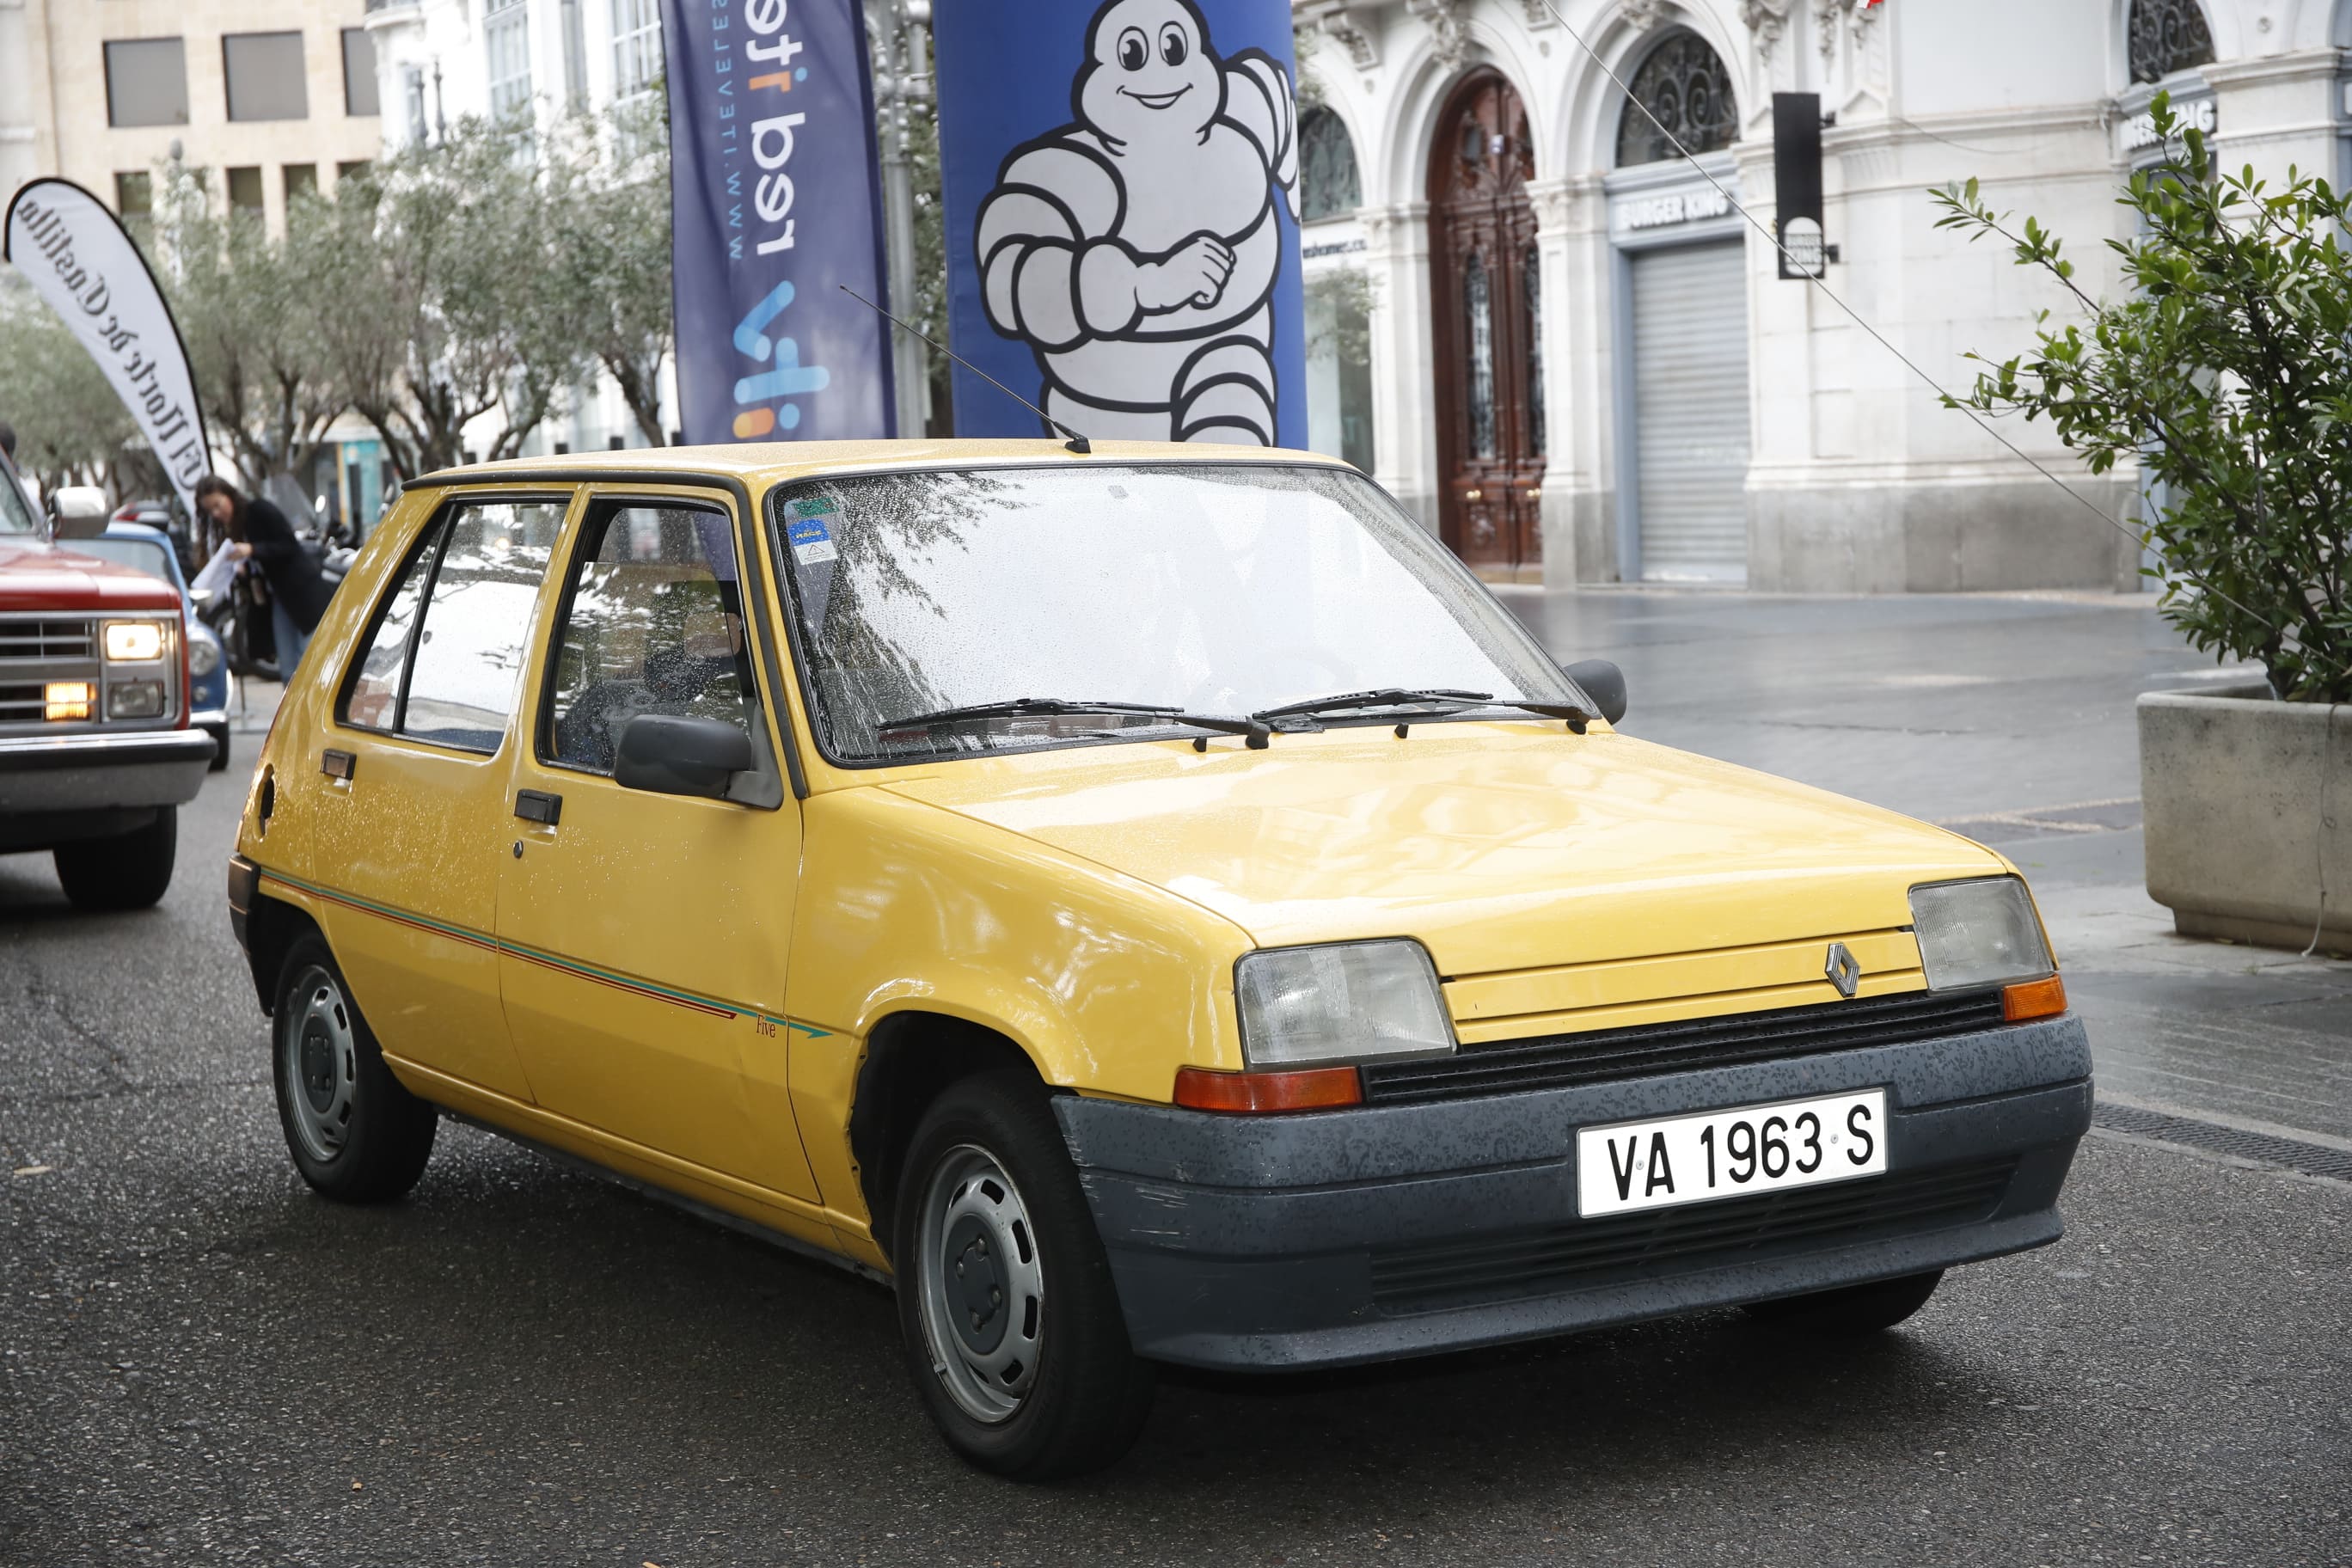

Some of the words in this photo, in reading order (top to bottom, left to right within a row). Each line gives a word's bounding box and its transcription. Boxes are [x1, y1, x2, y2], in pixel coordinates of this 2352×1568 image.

[1615, 195, 1684, 230] BURGER
[1685, 189, 1729, 220] KING
[756, 1014, 776, 1038] Five
[1607, 1131, 1675, 1202] VA
[1700, 1112, 1822, 1188] 1963
[1846, 1104, 1874, 1167] S
